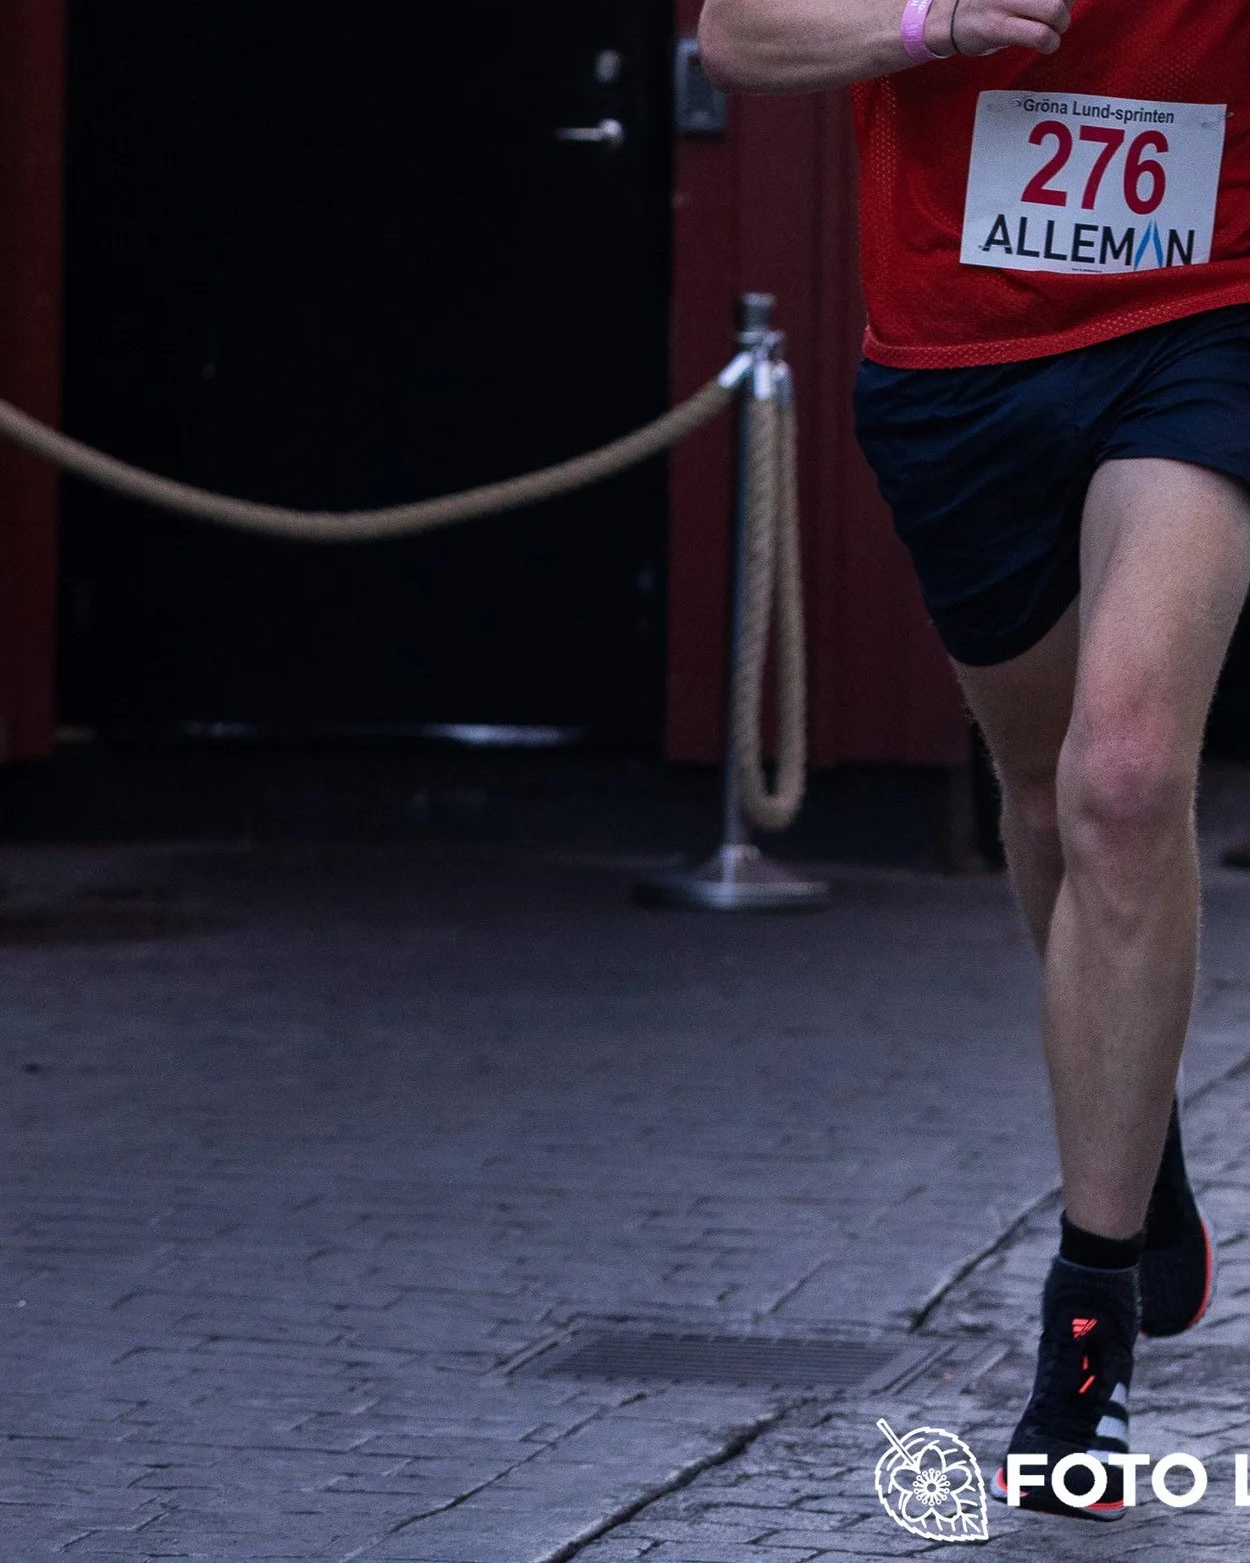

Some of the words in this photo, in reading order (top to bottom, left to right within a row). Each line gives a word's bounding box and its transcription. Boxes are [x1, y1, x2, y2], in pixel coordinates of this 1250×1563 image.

[1023, 98, 1068, 115] Gröna
[1072, 101, 1175, 124] Lund-sprinten
[1020, 120, 1169, 215] 276
[982, 214, 1195, 270] ALLEMAN
